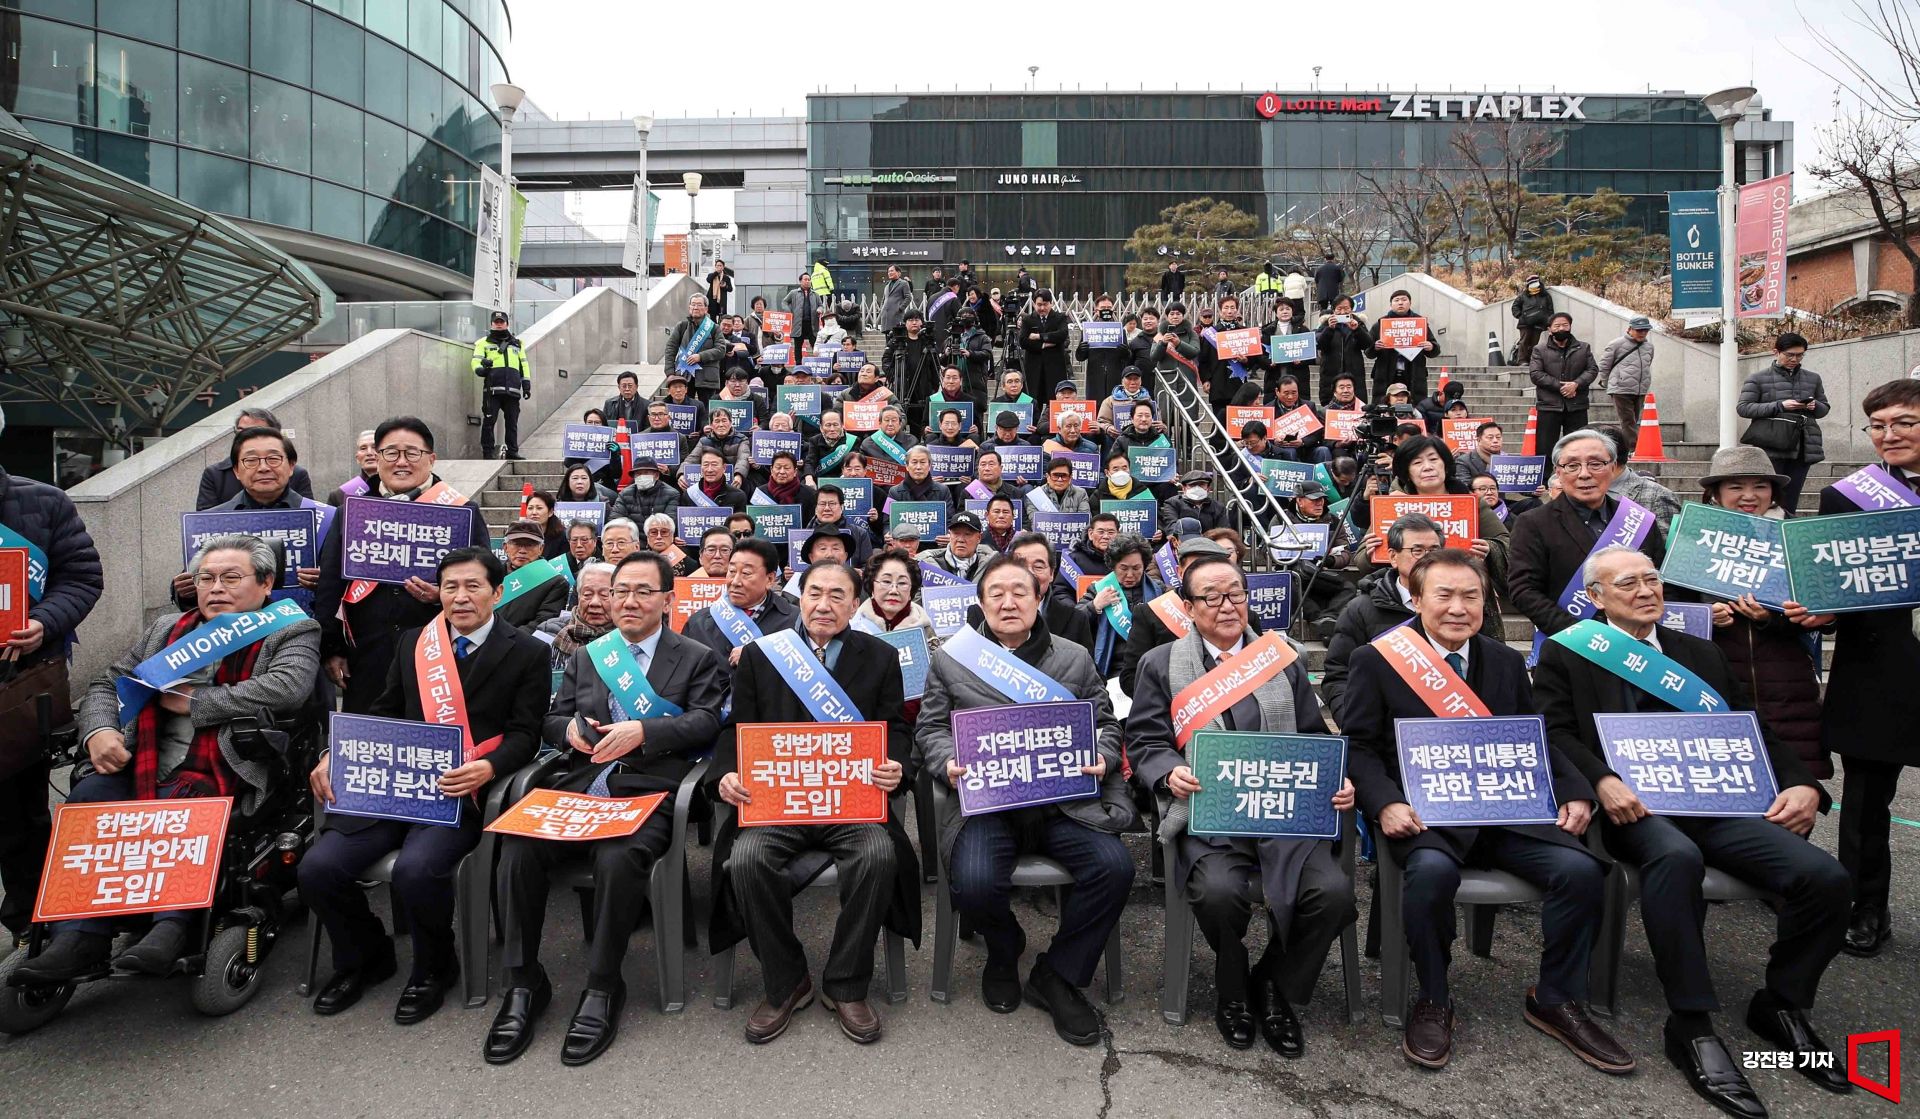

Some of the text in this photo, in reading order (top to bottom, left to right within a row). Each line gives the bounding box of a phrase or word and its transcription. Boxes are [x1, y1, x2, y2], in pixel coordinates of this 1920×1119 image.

[1286, 95, 1586, 119] LOTTE Mart ZETTAPLEX
[998, 174, 1028, 184] JUNO
[1032, 174, 1060, 184] HAIR
[1676, 252, 1714, 261] BOTTLE
[1676, 261, 1714, 270] BUNKER
[1766, 261, 1781, 309] PLACE
[568, 432, 588, 440] 제왕적
[569, 441, 606, 452] 권한 분산!
[655, 440, 676, 449] 대통령
[654, 448, 674, 458] 분산!
[1020, 454, 1040, 462] 대통령
[1135, 455, 1168, 465] 지방분권
[950, 463, 969, 472] 분산!
[1018, 462, 1038, 473] 분산!
[1141, 466, 1161, 477] 개헌!
[1269, 469, 1306, 481] 지방분권
[1494, 464, 1542, 474] 제왕적 대통령
[875, 474, 895, 484] 도입!
[1496, 474, 1538, 485] 권한 분산!
[681, 517, 705, 526] 제왕적
[756, 515, 792, 526] 지방분권
[899, 511, 938, 523] 지방분권
[364, 519, 452, 545] 지역대표형
[764, 526, 786, 537] 개헌!
[1036, 521, 1061, 531] 제왕적
[346, 540, 410, 568] 상원제
[1706, 557, 1769, 590] 개헌!
[1840, 561, 1908, 594] 개헌!
[691, 584, 727, 598] 헌법개
[1251, 586, 1286, 602] 대통령
[928, 596, 962, 610] 제왕적
[934, 613, 961, 628] 권한
[771, 732, 852, 756] 헌법개정
[976, 725, 1073, 754] 지역대표형
[338, 739, 453, 773] 제왕적 대통령
[1409, 742, 1537, 771] 제왕적 대통령
[1612, 737, 1756, 763] 제왕적 대통령
[750, 758, 873, 788] 국민발안제
[962, 750, 1091, 792] 상원제 도입!
[1216, 758, 1318, 790] 지방분권
[1630, 764, 1757, 794] 권한 분산!
[344, 766, 389, 796] 권한
[1421, 771, 1536, 802] 권한 분산!
[554, 796, 632, 812] 헌법개정
[784, 789, 841, 816] 도입!
[1234, 791, 1294, 820] 개헌!
[522, 805, 642, 824] 국민발안제
[96, 808, 192, 838] 헌법개정
[540, 822, 600, 838] 도입!
[62, 835, 209, 875] 국민발안제
[92, 872, 165, 905] 도입!
